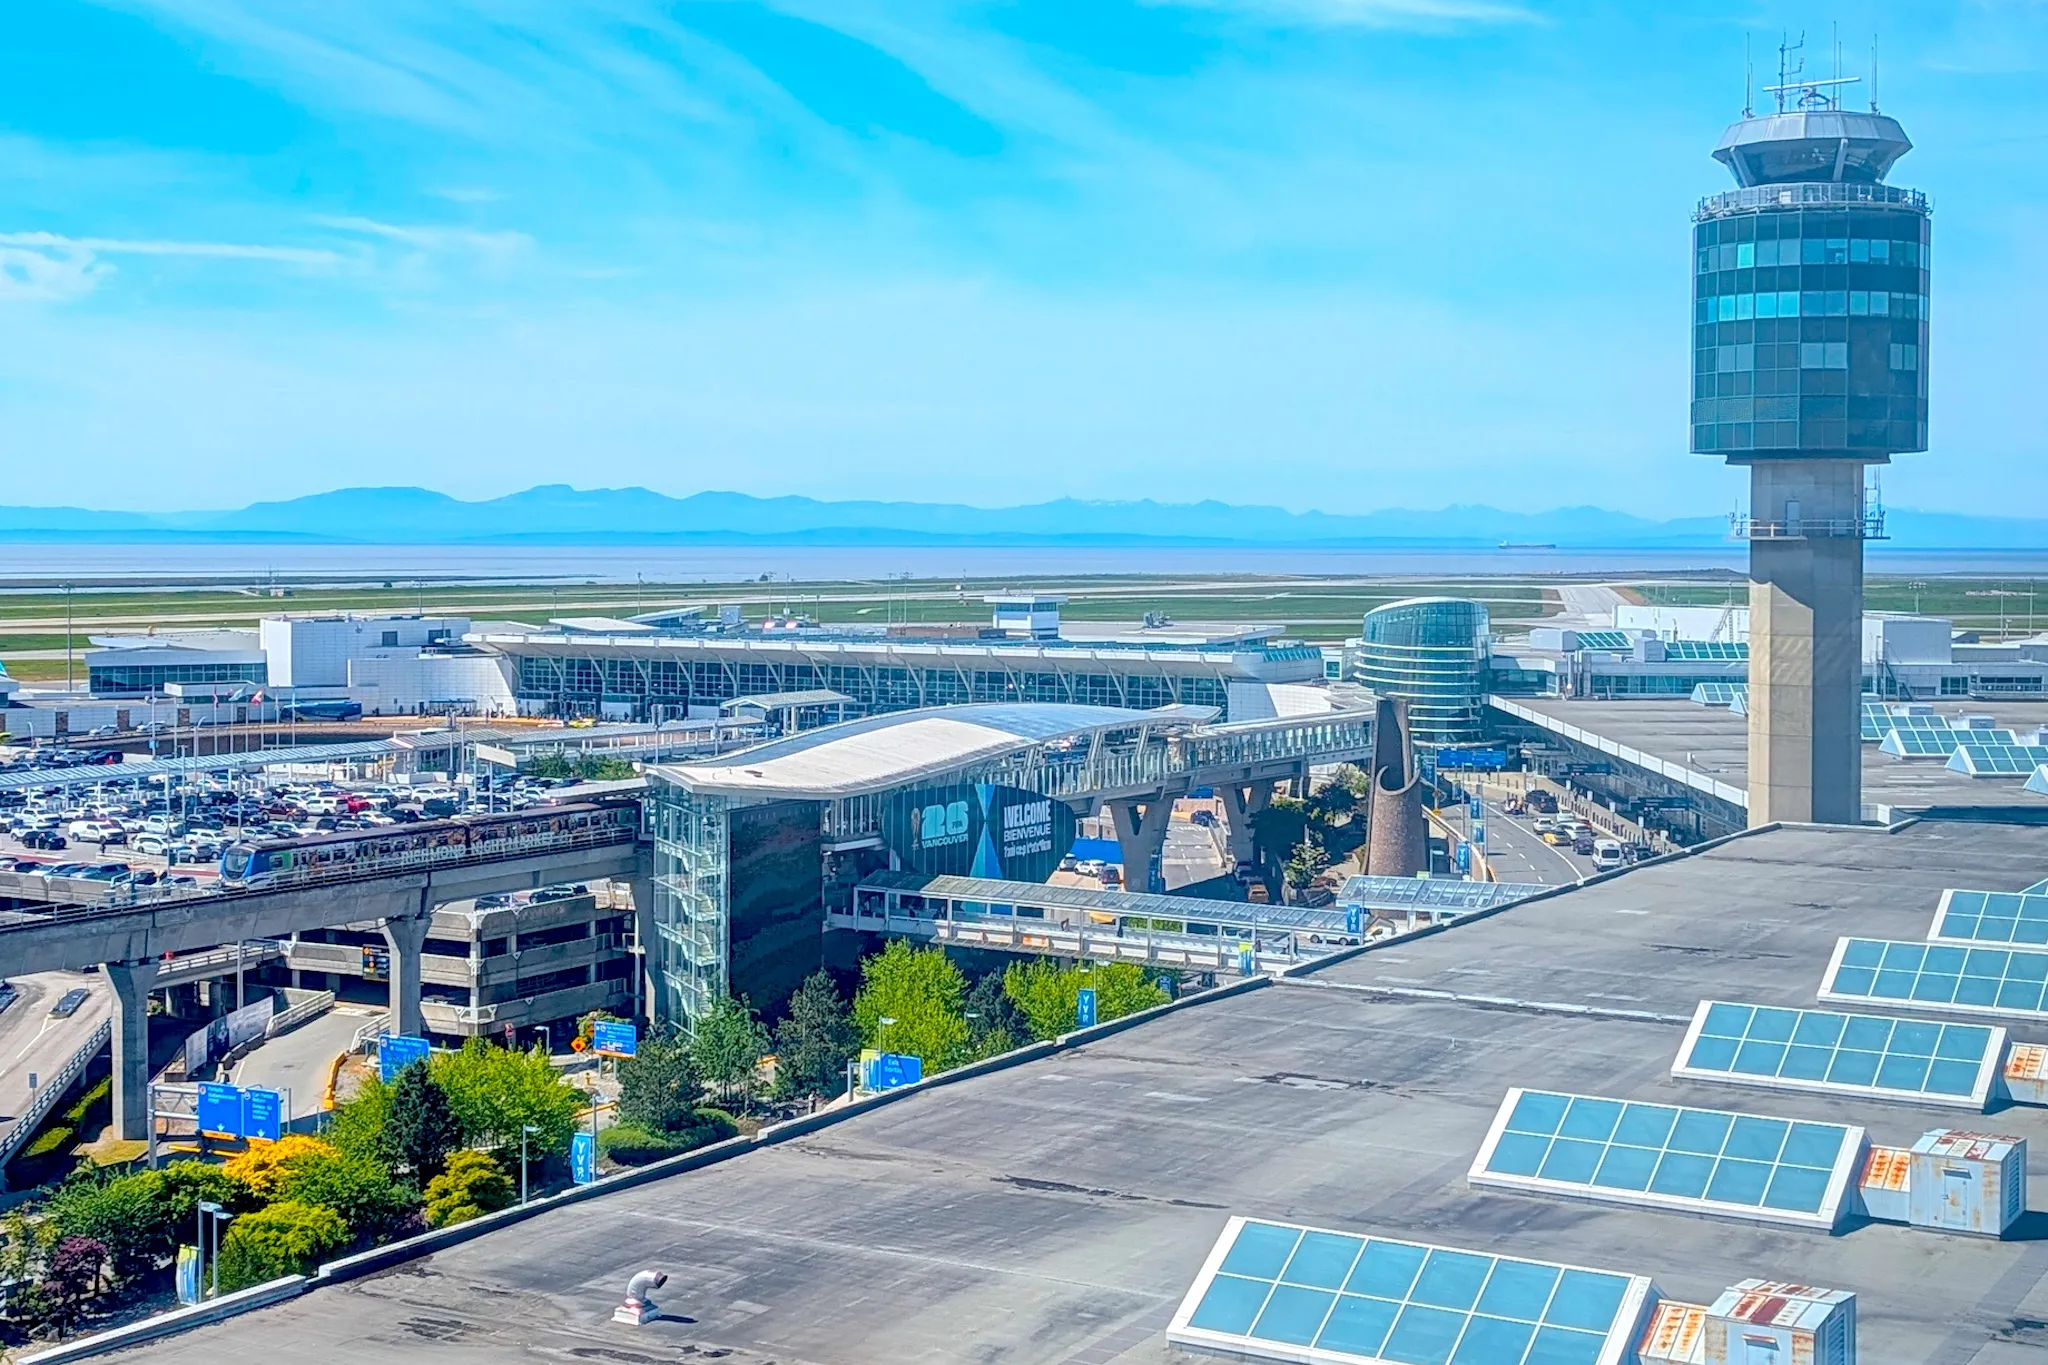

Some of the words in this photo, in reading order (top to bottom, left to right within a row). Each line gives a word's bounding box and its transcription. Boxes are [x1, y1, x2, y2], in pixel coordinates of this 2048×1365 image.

[921, 800, 969, 840] 26
[1003, 799, 1052, 829] WELCOME
[402, 843, 466, 863] RICHMOND
[471, 838, 507, 855] NIGHT
[508, 832, 555, 851] MARKET
[921, 833, 969, 849] VANCOUVER
[1003, 823, 1052, 843] BIENVENUE
[1082, 995, 1090, 1023] YVR
[887, 1059, 900, 1067] Exit
[577, 1141, 586, 1179] YVR
